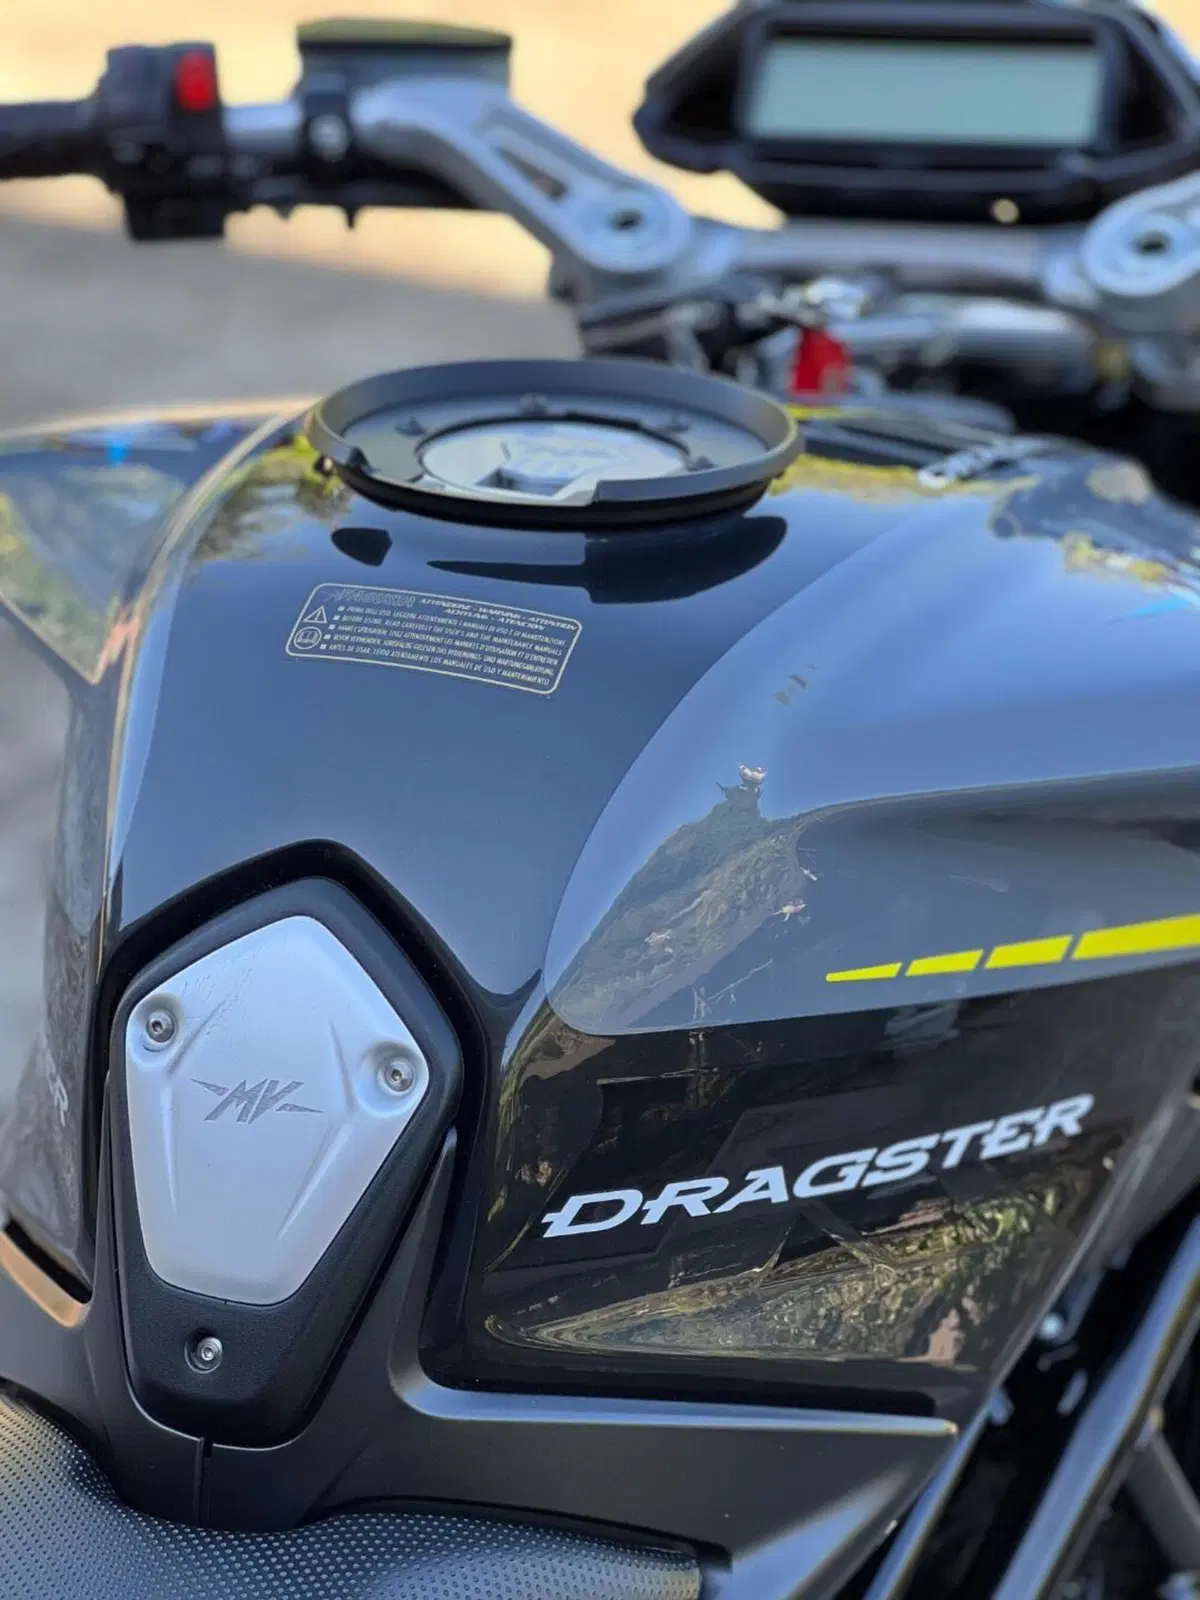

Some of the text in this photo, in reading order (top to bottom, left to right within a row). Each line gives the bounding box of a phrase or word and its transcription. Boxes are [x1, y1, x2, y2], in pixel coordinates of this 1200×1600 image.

[527, 617, 578, 631] ATTENTION
[194, 1076, 318, 1126] MV
[541, 1095, 1094, 1239] DRAGSTER
